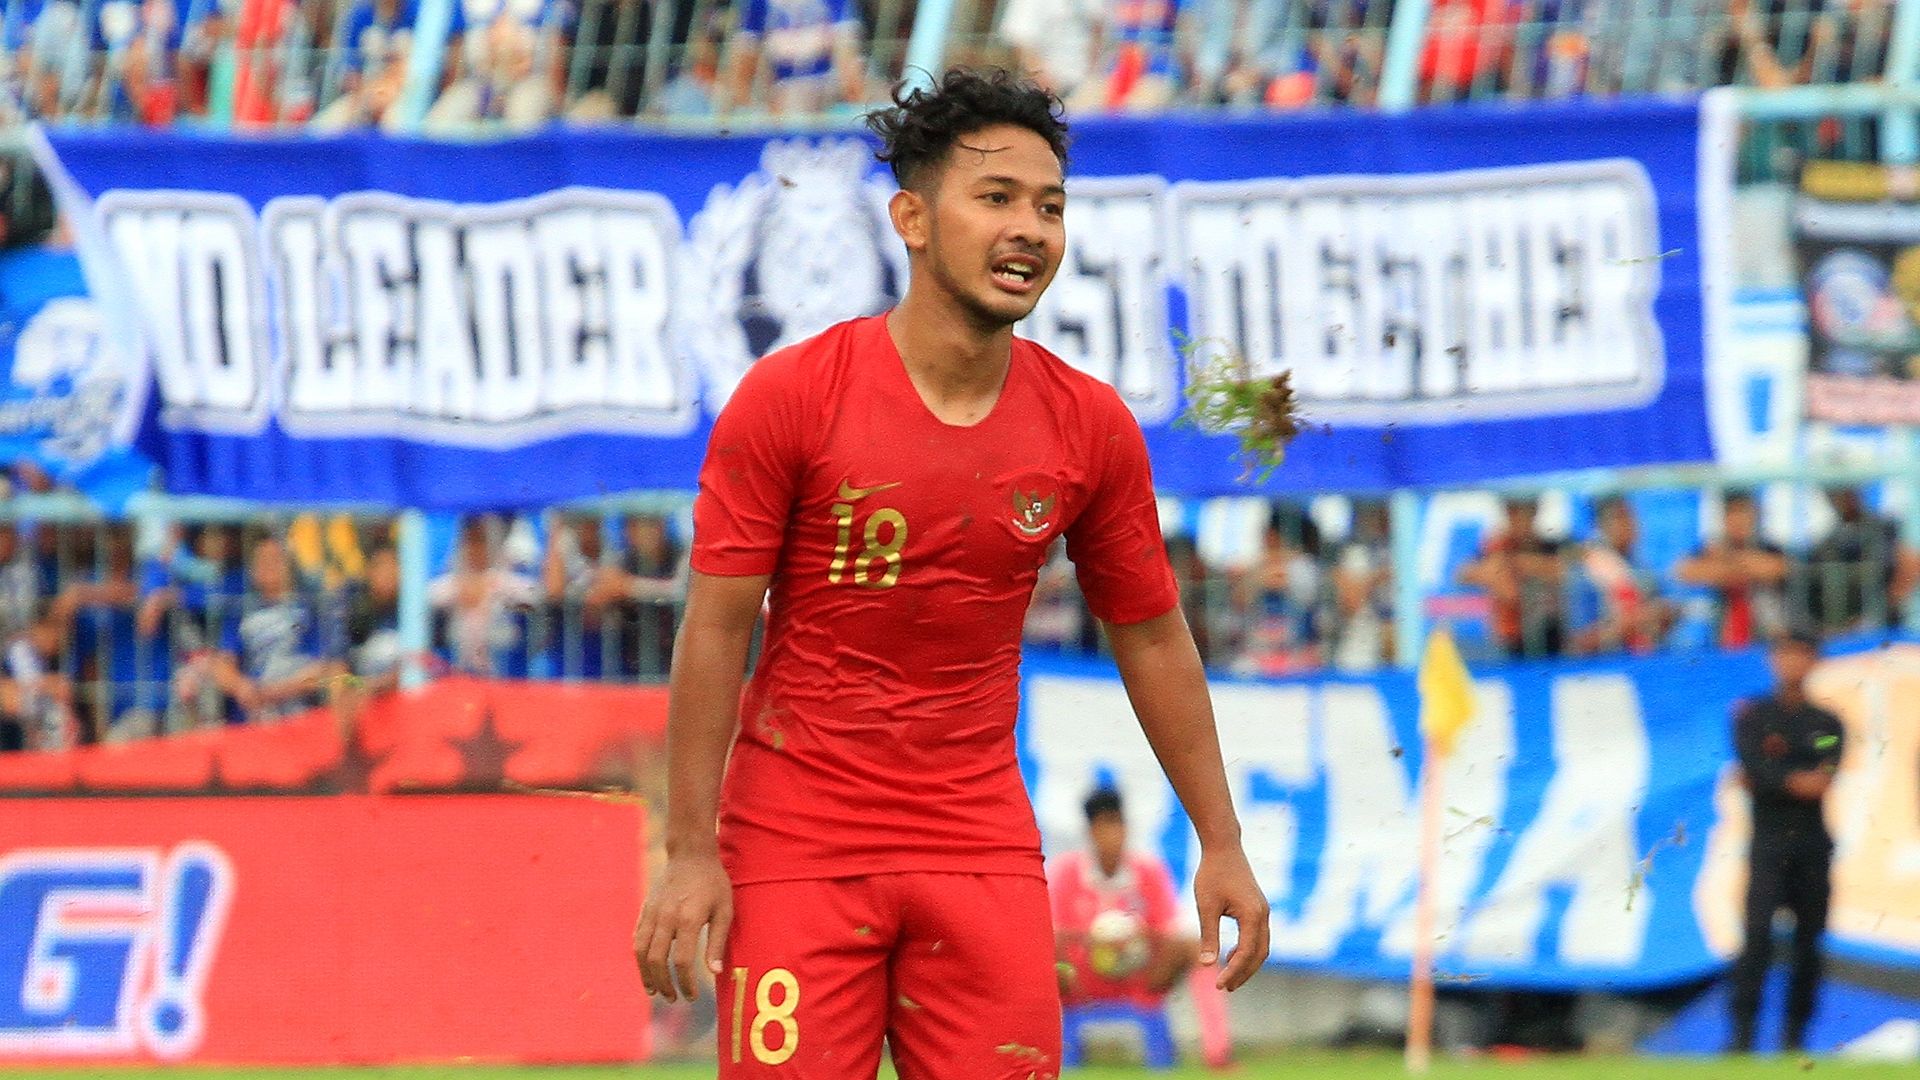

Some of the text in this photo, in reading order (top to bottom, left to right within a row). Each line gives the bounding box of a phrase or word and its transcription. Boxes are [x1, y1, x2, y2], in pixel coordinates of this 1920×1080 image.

[279, 204, 680, 418] LEADER
[1186, 182, 1644, 402] TOGETHER
[828, 504, 908, 588] 18
[731, 961, 800, 1065] 18
